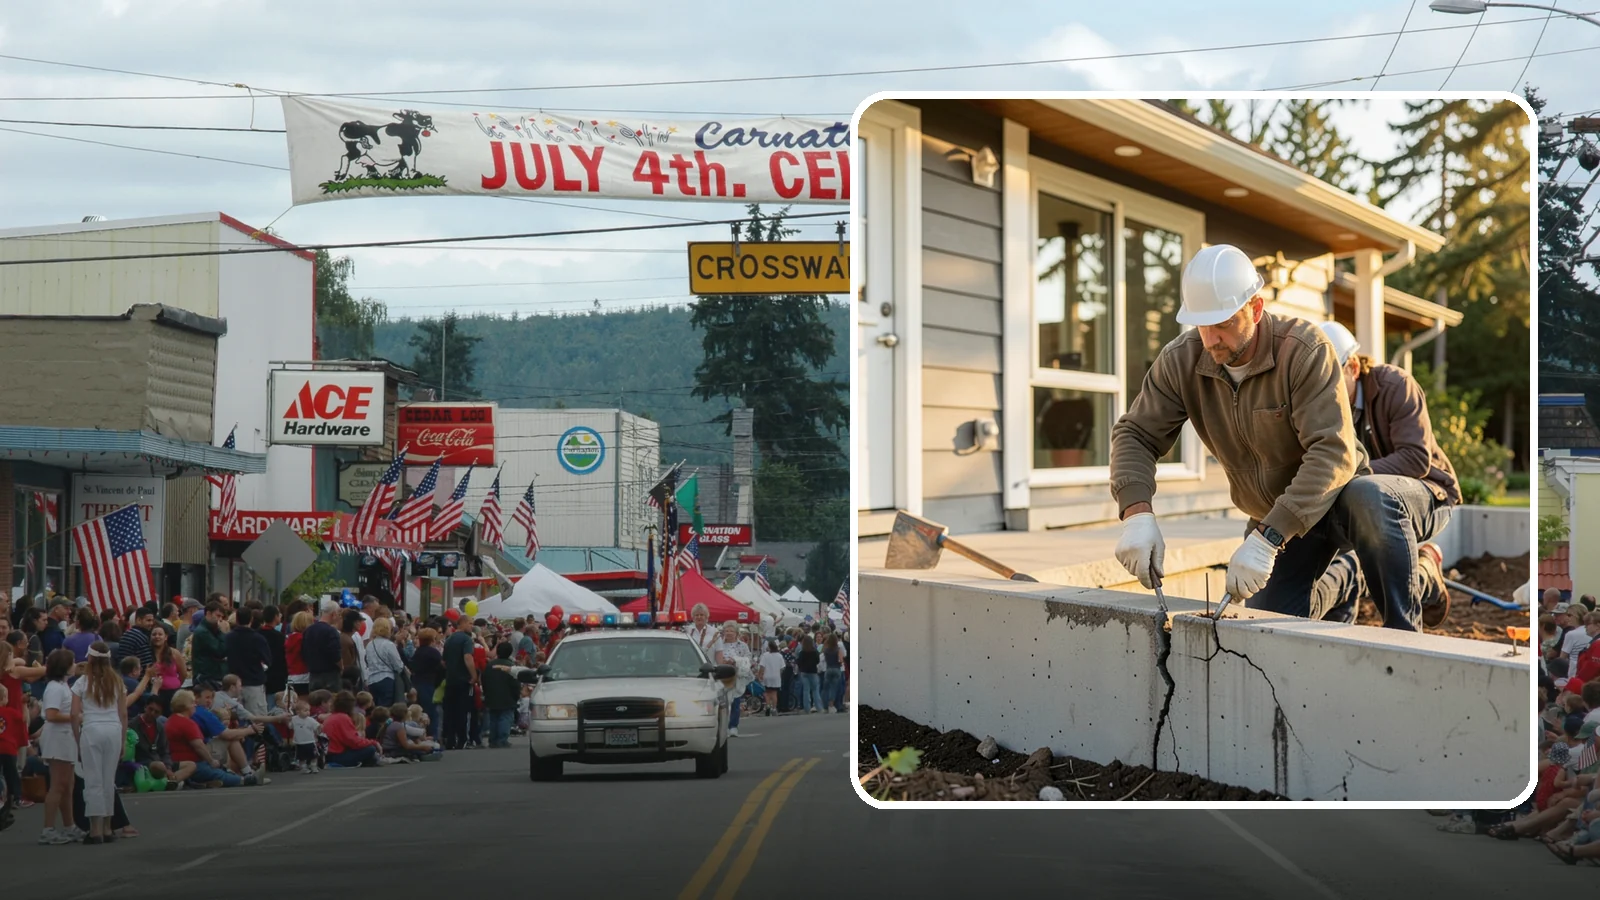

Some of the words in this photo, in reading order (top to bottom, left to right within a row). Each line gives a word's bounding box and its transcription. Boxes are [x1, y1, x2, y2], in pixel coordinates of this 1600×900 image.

[481, 141, 604, 193] JULY
[632, 150, 746, 198] 4th.
[697, 254, 850, 280] CROSSWA
[283, 380, 373, 420] ACE
[283, 421, 370, 436] Hardware
[96, 485, 124, 495] Vincent
[126, 485, 136, 494] de
[138, 485, 155, 495] Paul
[688, 526, 742, 535] CRNATION
[699, 535, 730, 543] GLASS
